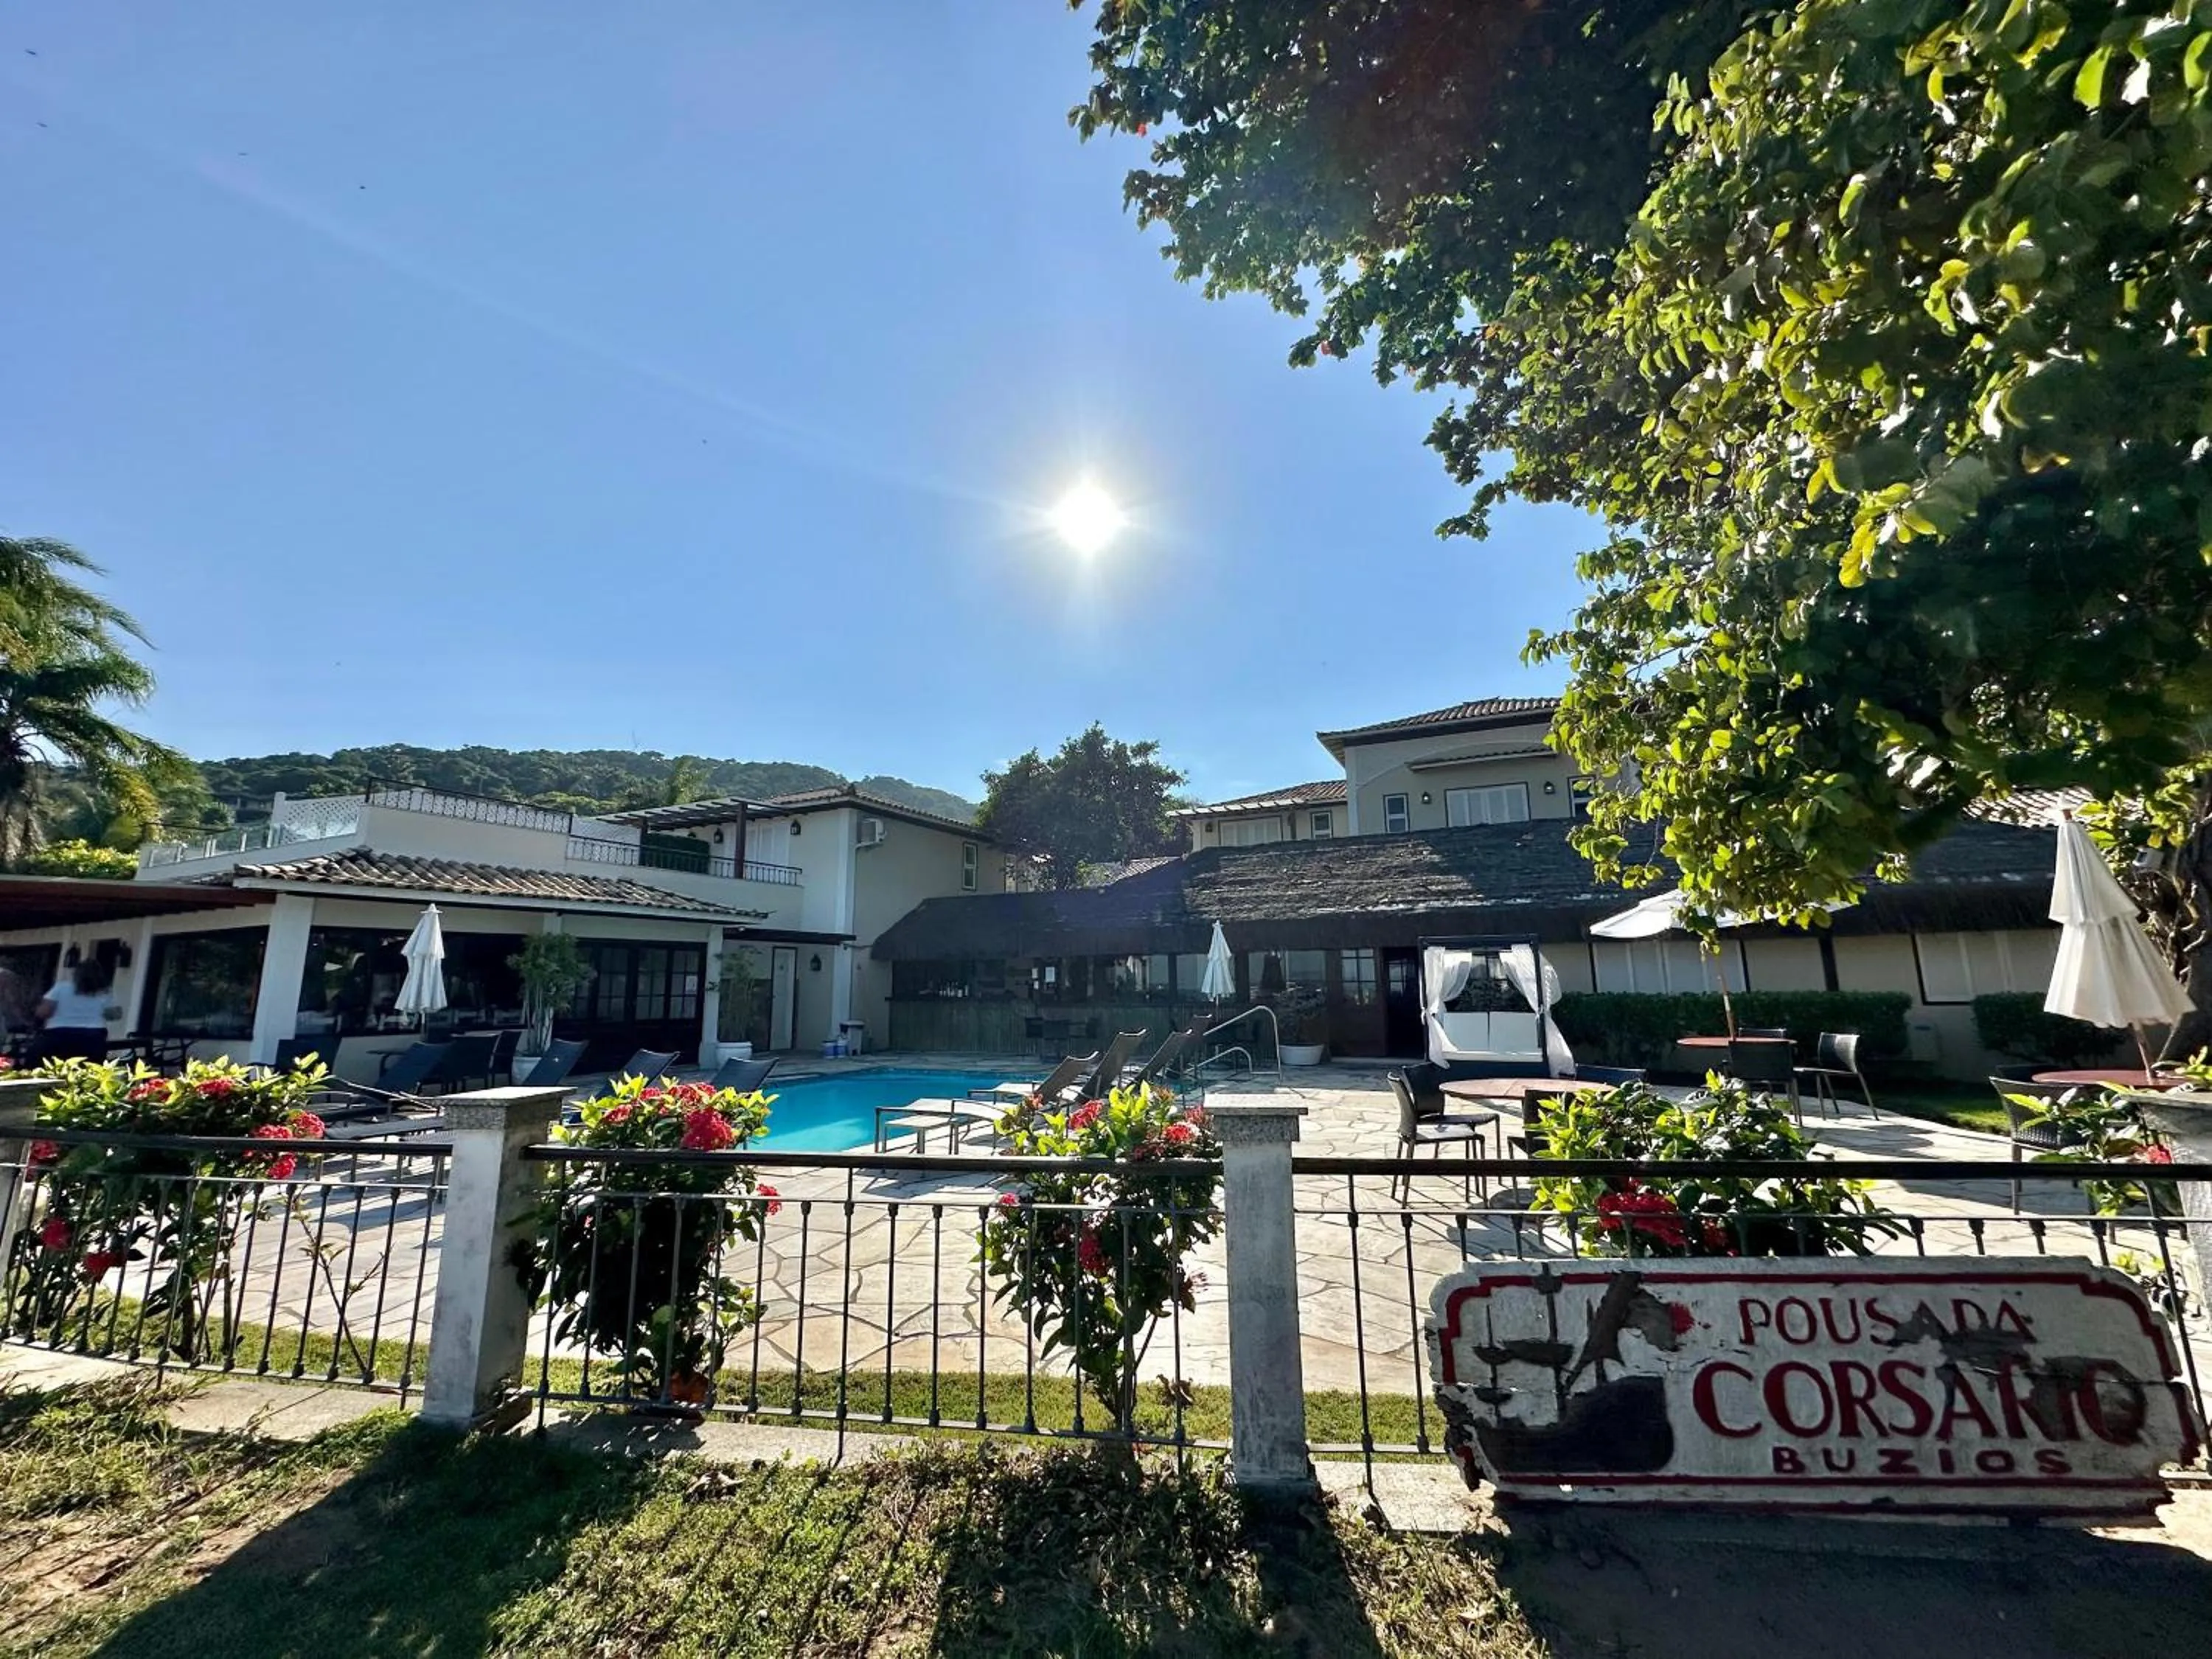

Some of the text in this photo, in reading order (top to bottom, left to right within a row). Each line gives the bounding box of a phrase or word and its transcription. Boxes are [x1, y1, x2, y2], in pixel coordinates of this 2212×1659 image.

[1739, 1296, 2038, 1346] POUSADA
[1693, 1358, 2147, 1446] CORSARIO
[1772, 1447, 2073, 1474] BUZIOS
